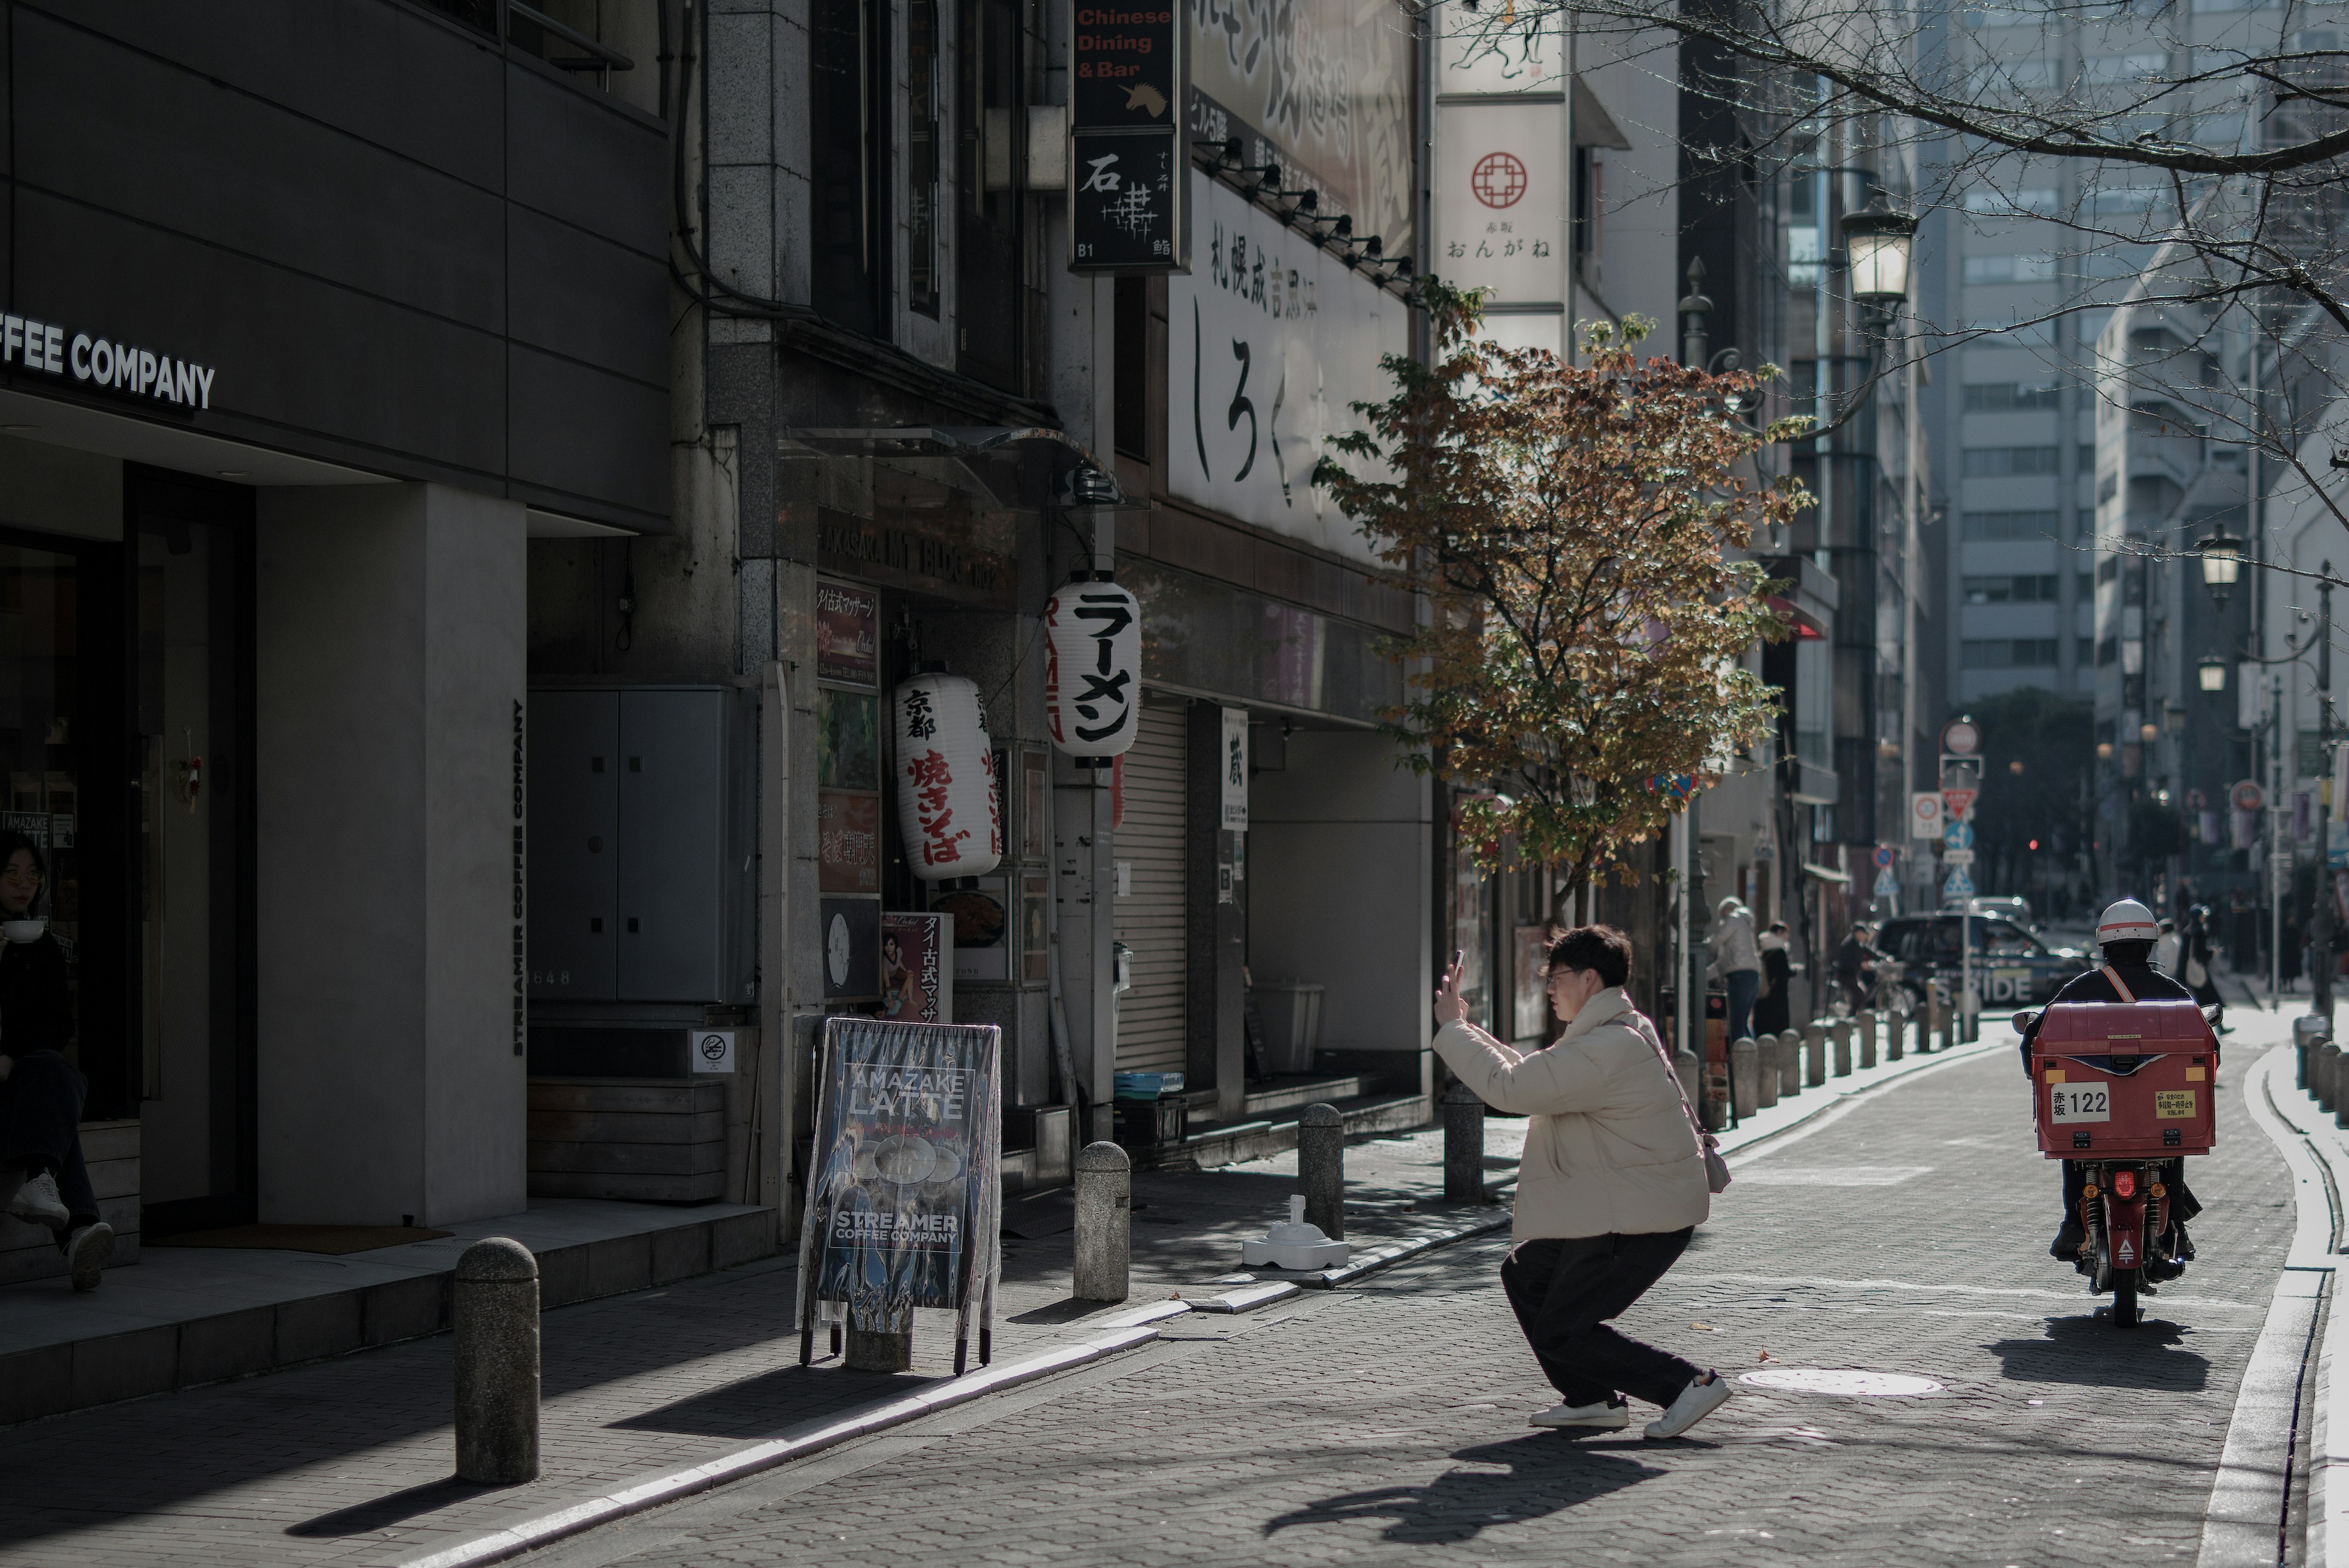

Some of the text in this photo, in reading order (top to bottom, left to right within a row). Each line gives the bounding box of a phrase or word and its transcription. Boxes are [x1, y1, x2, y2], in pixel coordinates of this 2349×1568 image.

[1077, 9, 1171, 25] Chinese
[1077, 34, 1152, 54] Dining
[1078, 61, 1141, 78] & Bar
[1486, 221, 1513, 234] 赤坂
[1078, 243, 1093, 258] B1
[1152, 239, 1171, 256] 鮨
[1447, 239, 1550, 259] おんがね
[0, 312, 215, 409] FEE COMPANY
[817, 588, 874, 618] タイ古式マッサージ
[1074, 594, 1132, 742] ラーメン
[904, 689, 937, 741] 京都
[907, 749, 971, 866] 焼きそば
[7, 816, 48, 830] AMAZAKE
[818, 828, 875, 865] そば専門天
[514, 699, 524, 1057] STREAMER COFFEE COMPANY
[920, 916, 939, 1023] タイ古式マッサ
[852, 1070, 965, 1093] AMAZAKE
[849, 1089, 964, 1120] LATTE
[2054, 1092, 2066, 1116] 赤坂
[2070, 1092, 2107, 1113] 122
[836, 1210, 958, 1232] STREAMER
[836, 1228, 958, 1244] COFFEE COMPANY
